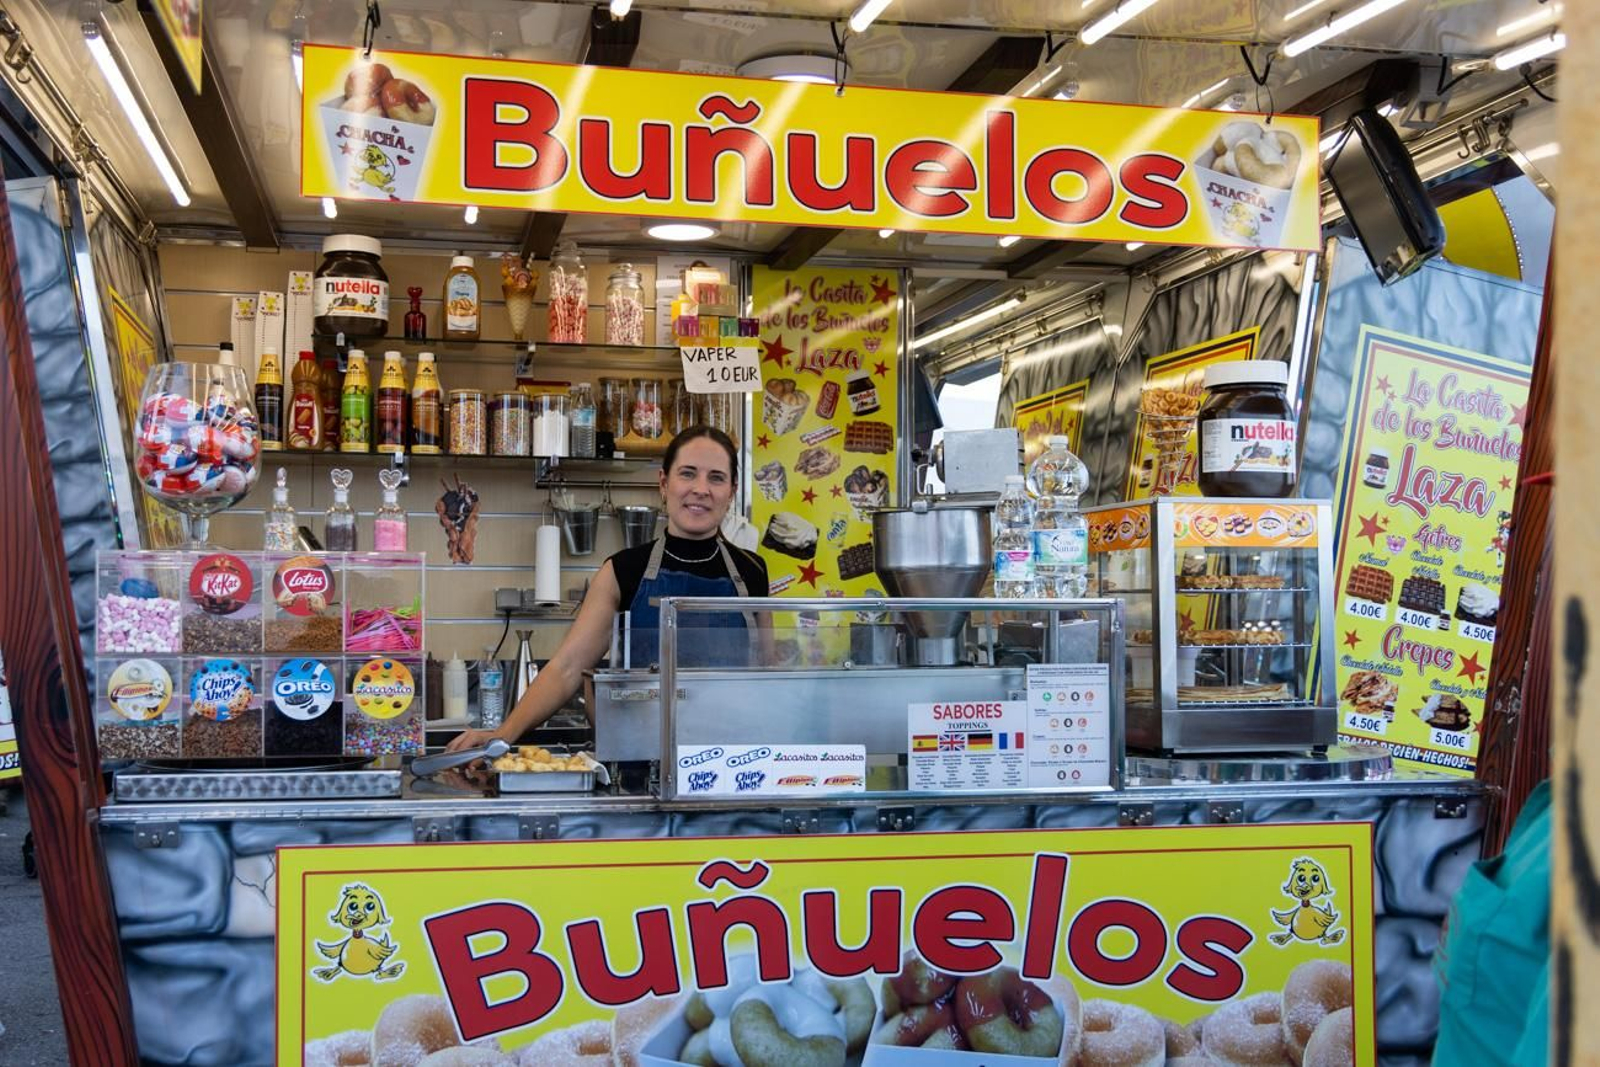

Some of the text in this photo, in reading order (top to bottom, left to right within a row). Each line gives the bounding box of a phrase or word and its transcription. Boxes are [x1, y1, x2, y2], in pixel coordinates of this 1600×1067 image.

[338, 123, 409, 151] CHACHA
[463, 75, 1189, 229] Buñuelos
[325, 280, 380, 296] nutella
[809, 275, 868, 305] Casita
[786, 305, 809, 330] los
[682, 347, 738, 363] VAPER
[795, 337, 865, 377] Laza
[1437, 372, 1507, 421] Casita
[1230, 421, 1294, 442] nutella
[1371, 401, 1523, 463] de los Buñuelos
[1386, 442, 1495, 520] Laza
[206, 574, 238, 595] KitKat
[288, 571, 324, 587] Lotus
[1349, 601, 1382, 619] 4.00€
[1400, 611, 1432, 629] 4.00€
[1462, 624, 1494, 641] 4.50€
[1381, 623, 1456, 676] Crepes
[202, 675, 237, 691] Chips
[203, 679, 242, 702] Ahoy!
[276, 680, 333, 697] OREO
[933, 703, 1003, 720] SABORES
[947, 721, 990, 730] TOPPINGS
[1348, 715, 1382, 732] 4.50€
[1434, 733, 1466, 749] 5.00€
[679, 747, 724, 768] OREO
[726, 747, 771, 768] OREO
[773, 752, 818, 762] Lacasitos
[820, 752, 864, 762] Lacasitos
[1422, 749, 1470, 769] HECHOS!
[687, 770, 714, 784] Chips
[688, 775, 718, 793] Ahoy!
[735, 770, 761, 784] Chips
[735, 775, 766, 793] Ahoy!
[423, 853, 1255, 1043] Buñuelos
